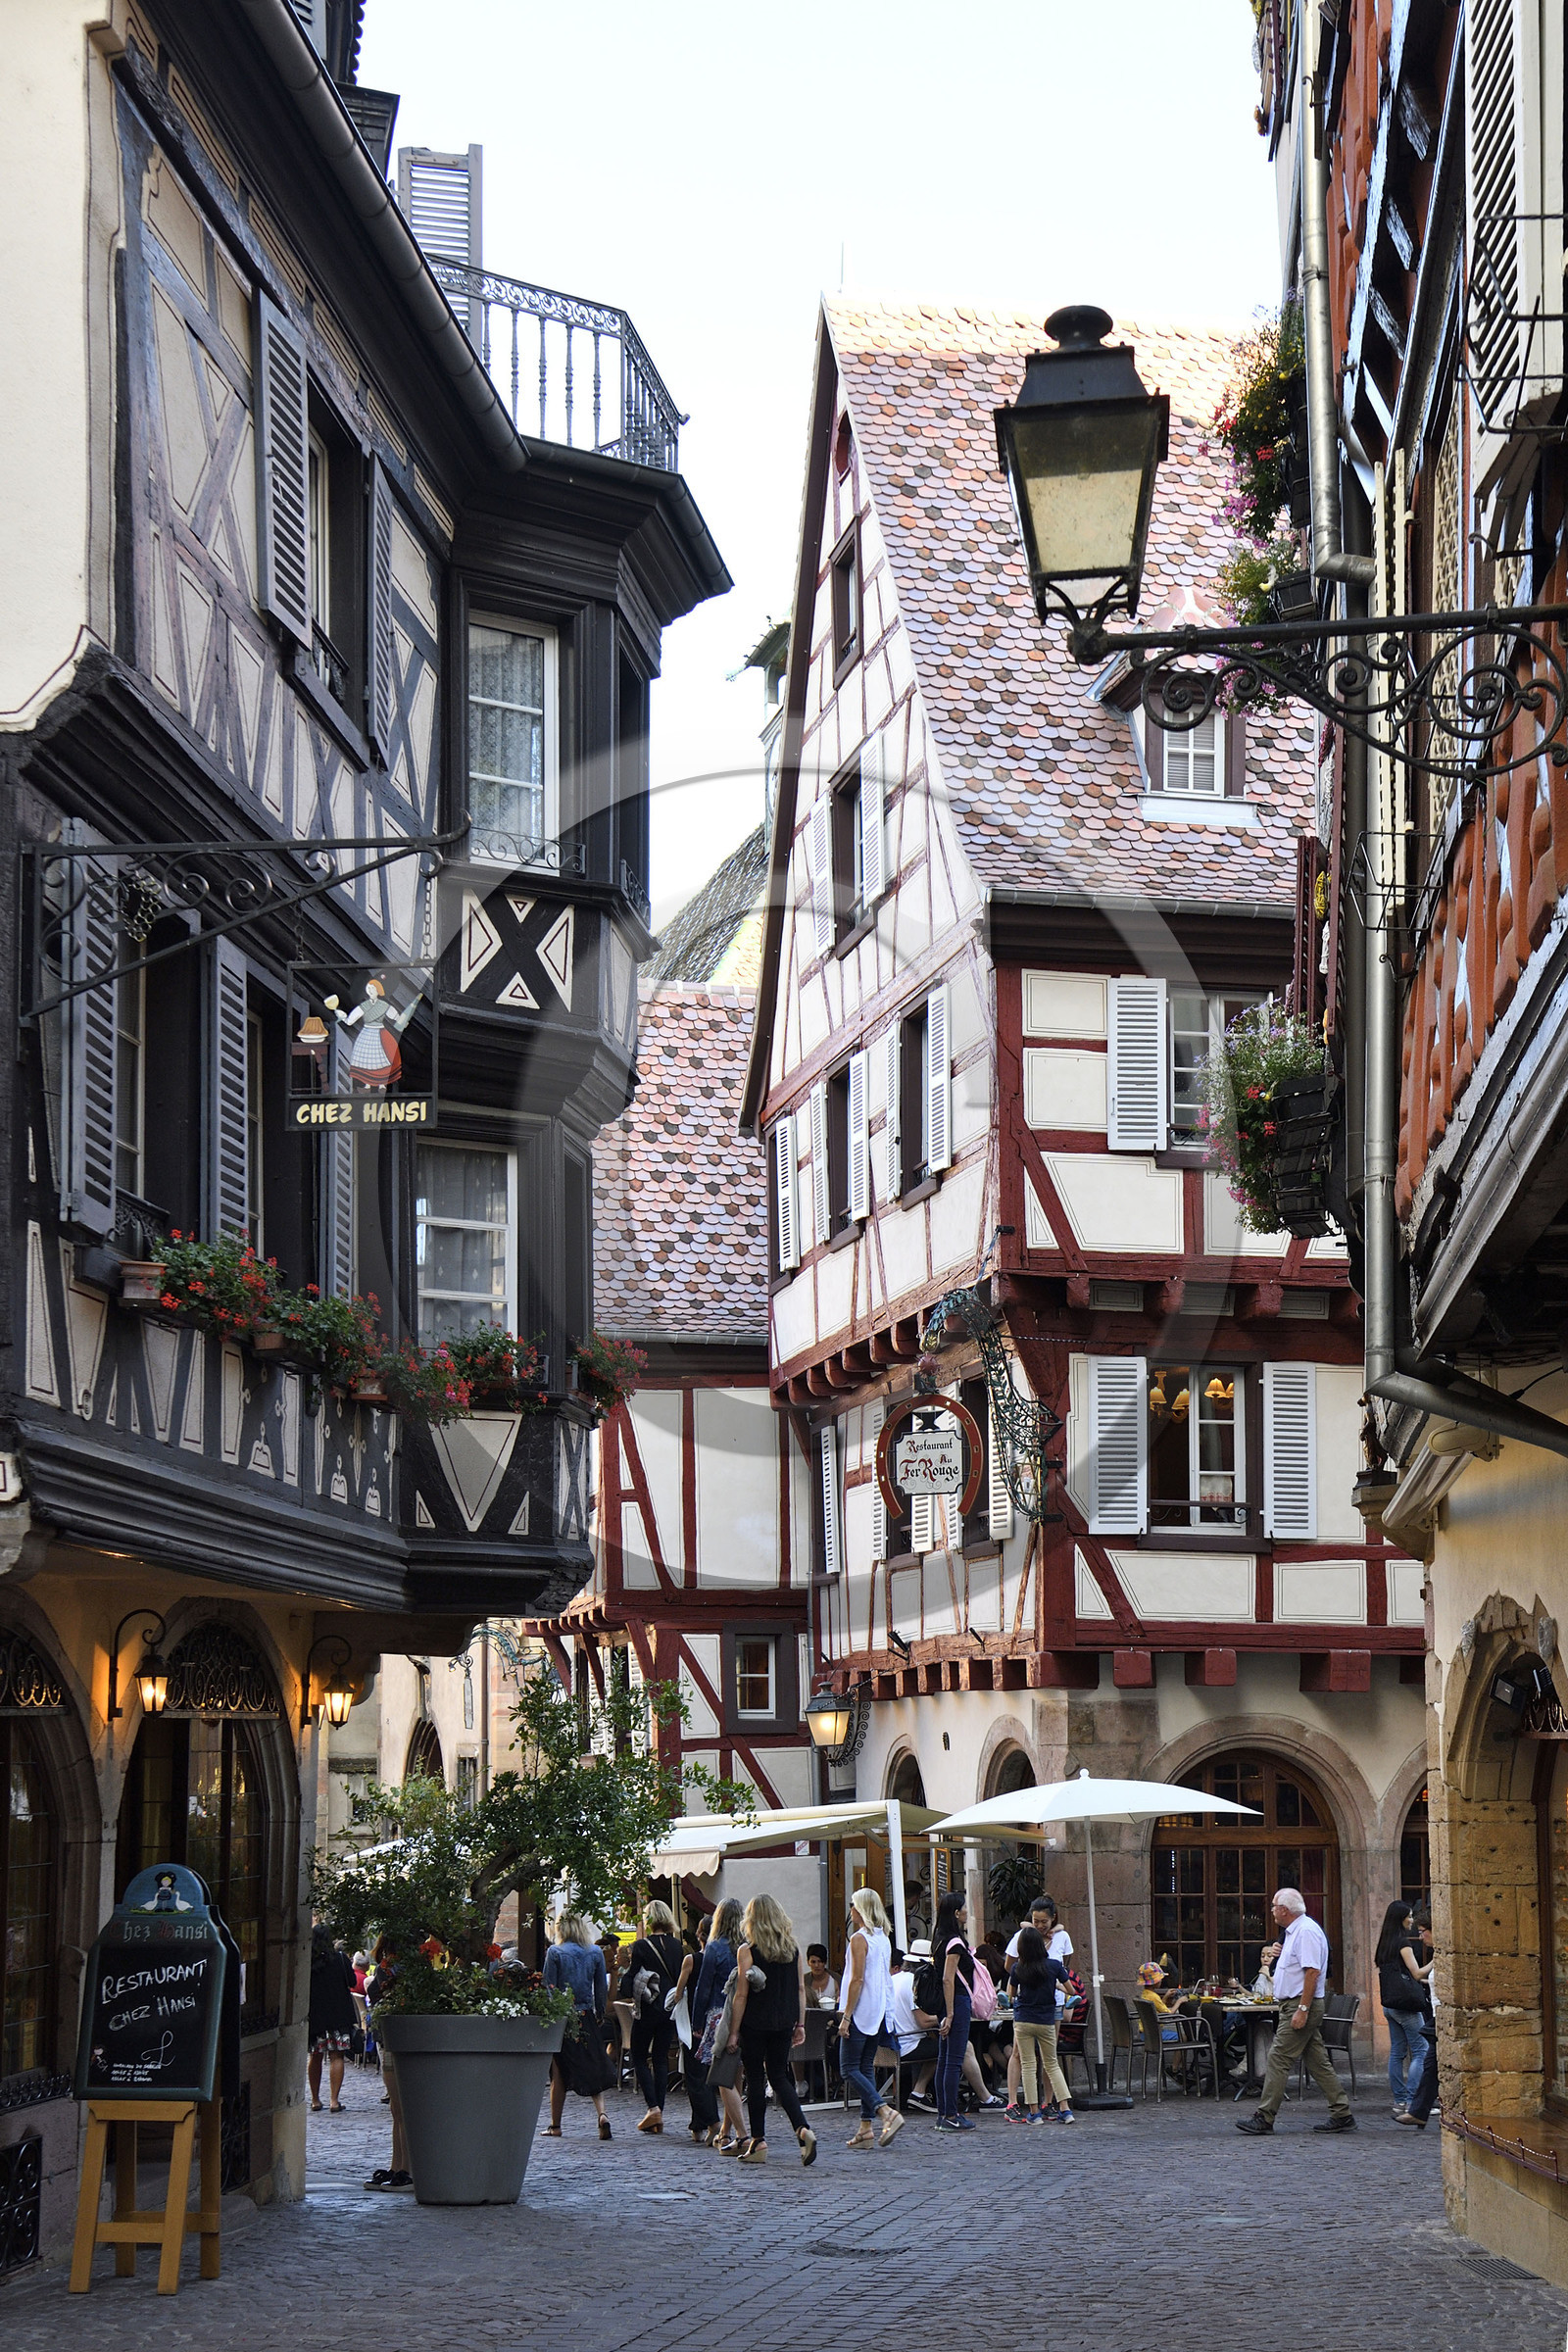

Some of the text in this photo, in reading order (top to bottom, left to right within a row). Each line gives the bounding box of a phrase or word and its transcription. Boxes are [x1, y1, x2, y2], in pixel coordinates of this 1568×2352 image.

[296, 1102, 427, 1124] CHEZ HANSI
[906, 1438, 954, 1453] Restaurant
[939, 1453, 953, 1464] Au
[900, 1458, 959, 1482] Fer Rouge
[110, 1921, 208, 1942] Chez Hansi
[102, 1959, 208, 2004] RESTAURANT
[109, 2005, 151, 2031] CHEZ
